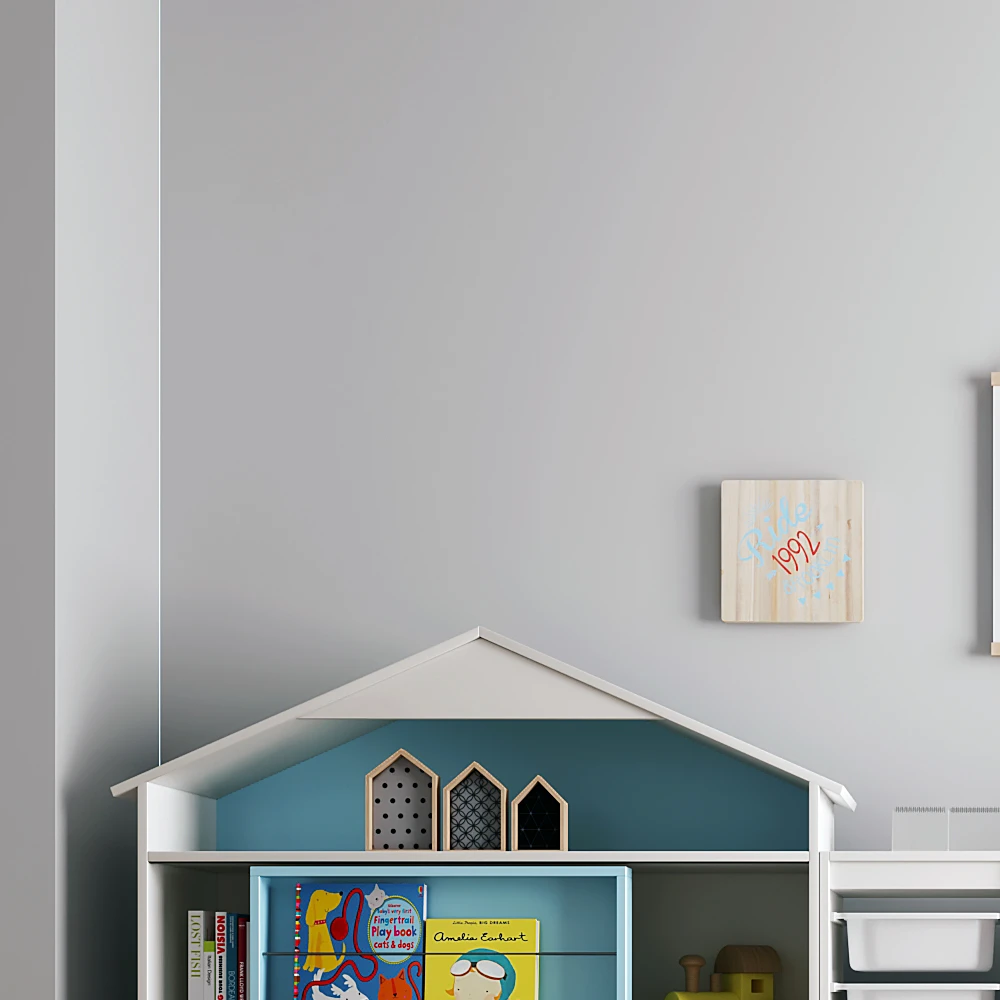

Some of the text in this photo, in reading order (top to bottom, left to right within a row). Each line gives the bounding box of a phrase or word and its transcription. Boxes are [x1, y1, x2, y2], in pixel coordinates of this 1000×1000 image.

[737, 496, 812, 568] Ride
[772, 531, 821, 575] 1992
[217, 915, 226, 954] VISION
[371, 925, 417, 941] Play book
[373, 916, 415, 926] Fingertrail
[190, 915, 201, 978] LOST FISH
[391, 940, 396, 949] &
[398, 940, 414, 950] dogs
[433, 931, 529, 942] Amelia Earhart
